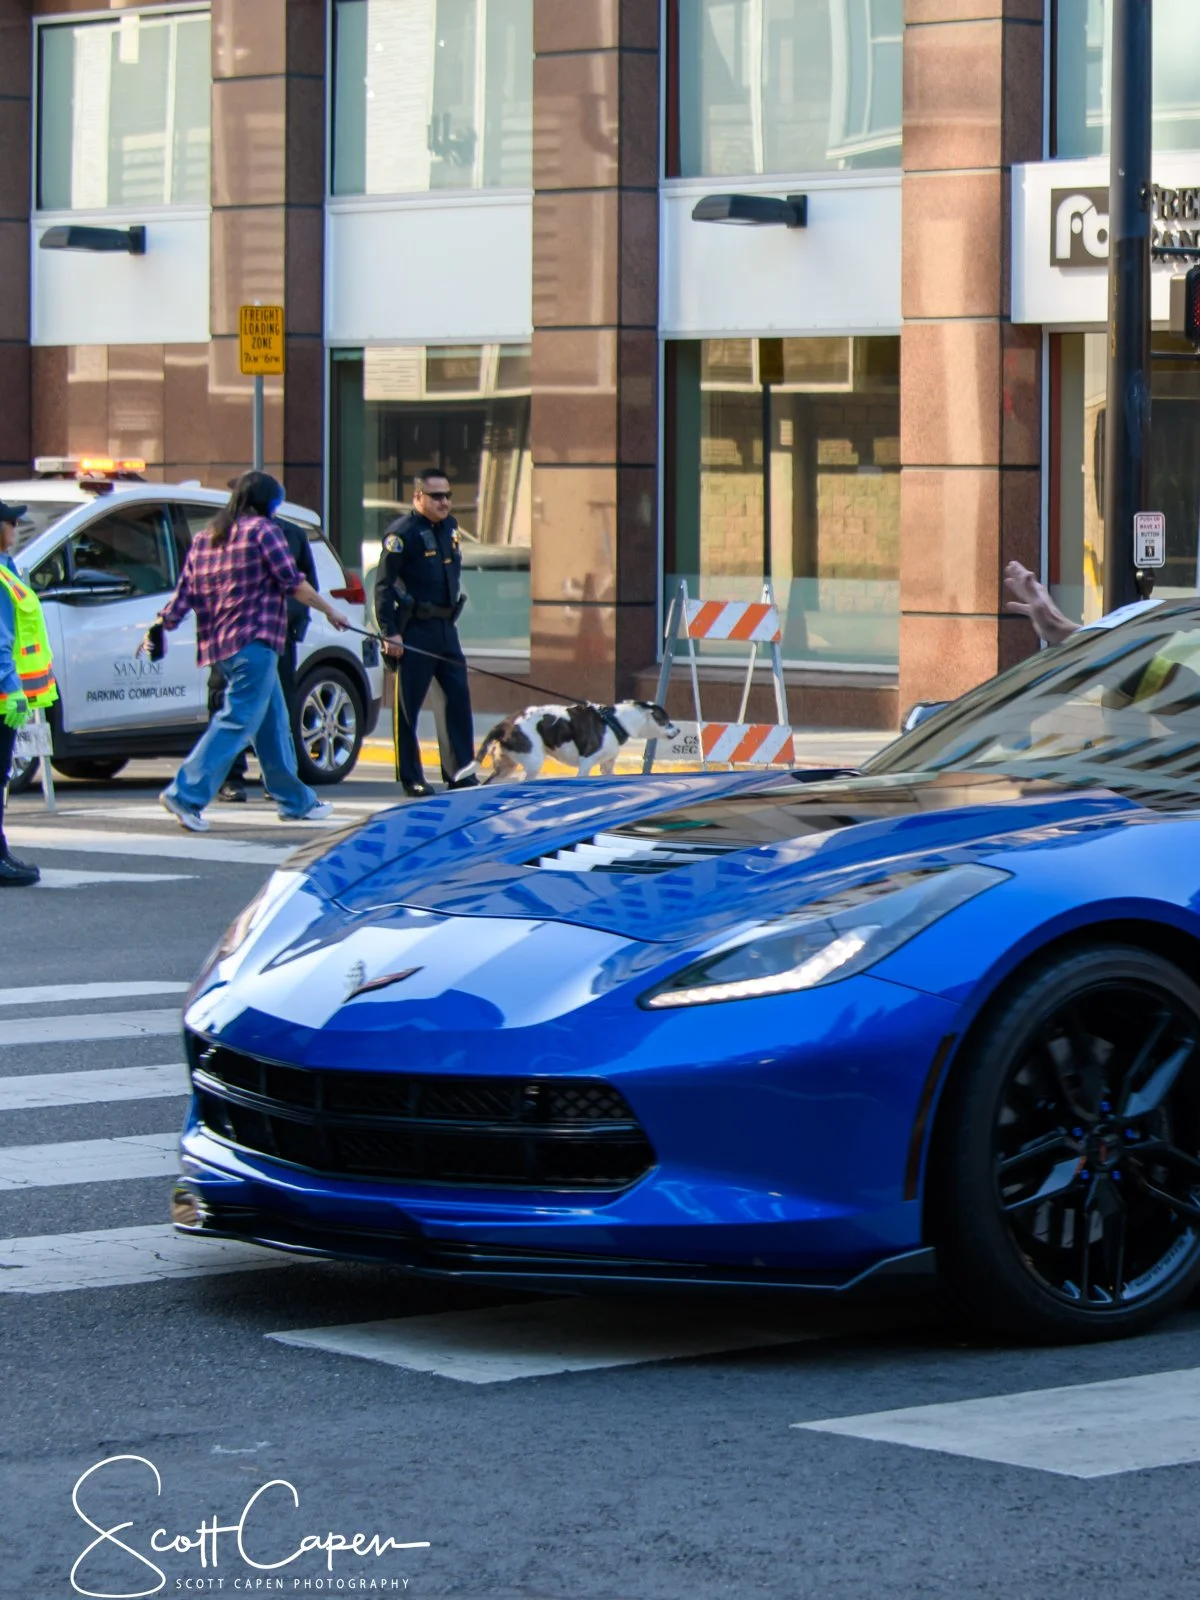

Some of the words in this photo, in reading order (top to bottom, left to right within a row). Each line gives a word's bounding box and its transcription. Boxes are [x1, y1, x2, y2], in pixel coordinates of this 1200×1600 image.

[244, 309, 279, 321] FREIGHT
[244, 323, 280, 336] LOADING
[252, 337, 272, 350] ZONE
[113, 661, 137, 677] SAN
[87, 688, 125, 702] PARKING
[128, 686, 186, 700] COMPLIANCE
